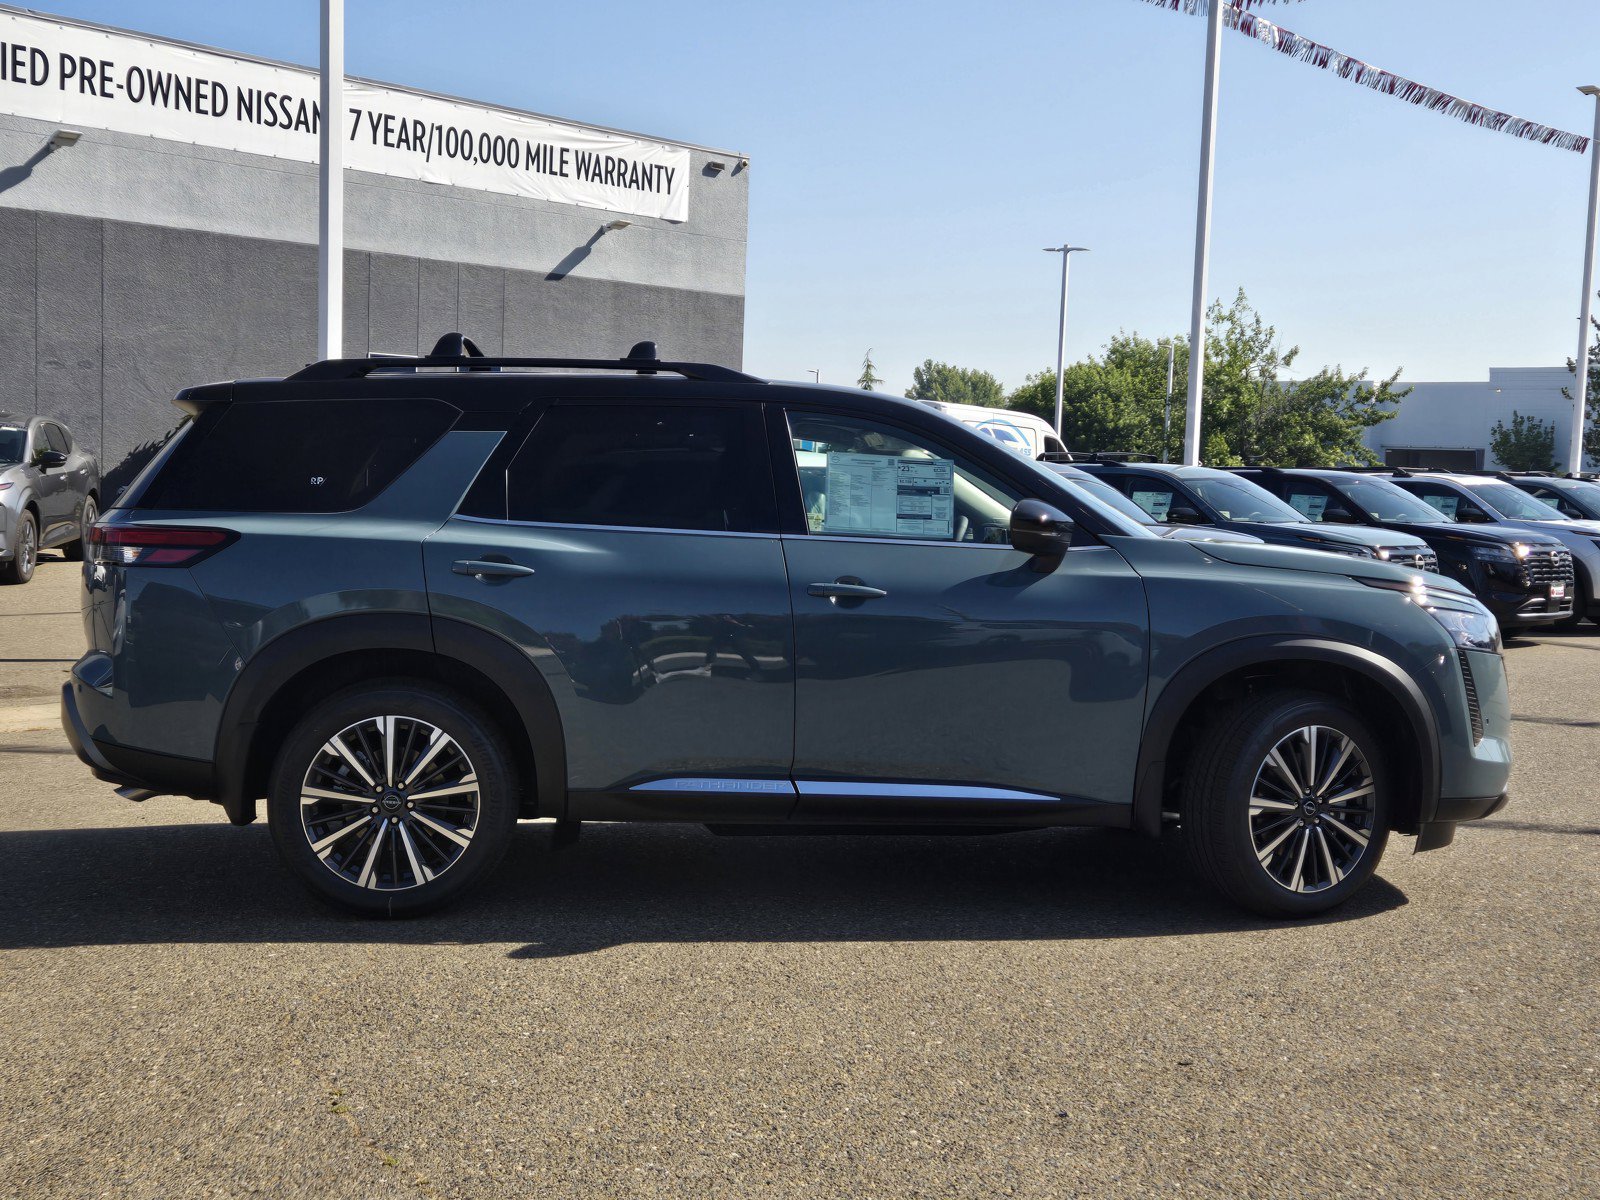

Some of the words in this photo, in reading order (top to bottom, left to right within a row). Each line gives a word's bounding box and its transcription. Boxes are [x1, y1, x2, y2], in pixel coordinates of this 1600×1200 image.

[59, 52, 228, 118] PRE-OWNED
[349, 108, 362, 141] 7
[367, 111, 520, 169] YEAR/100,000
[525, 142, 569, 179] MILE
[575, 149, 676, 196] WARRANTY
